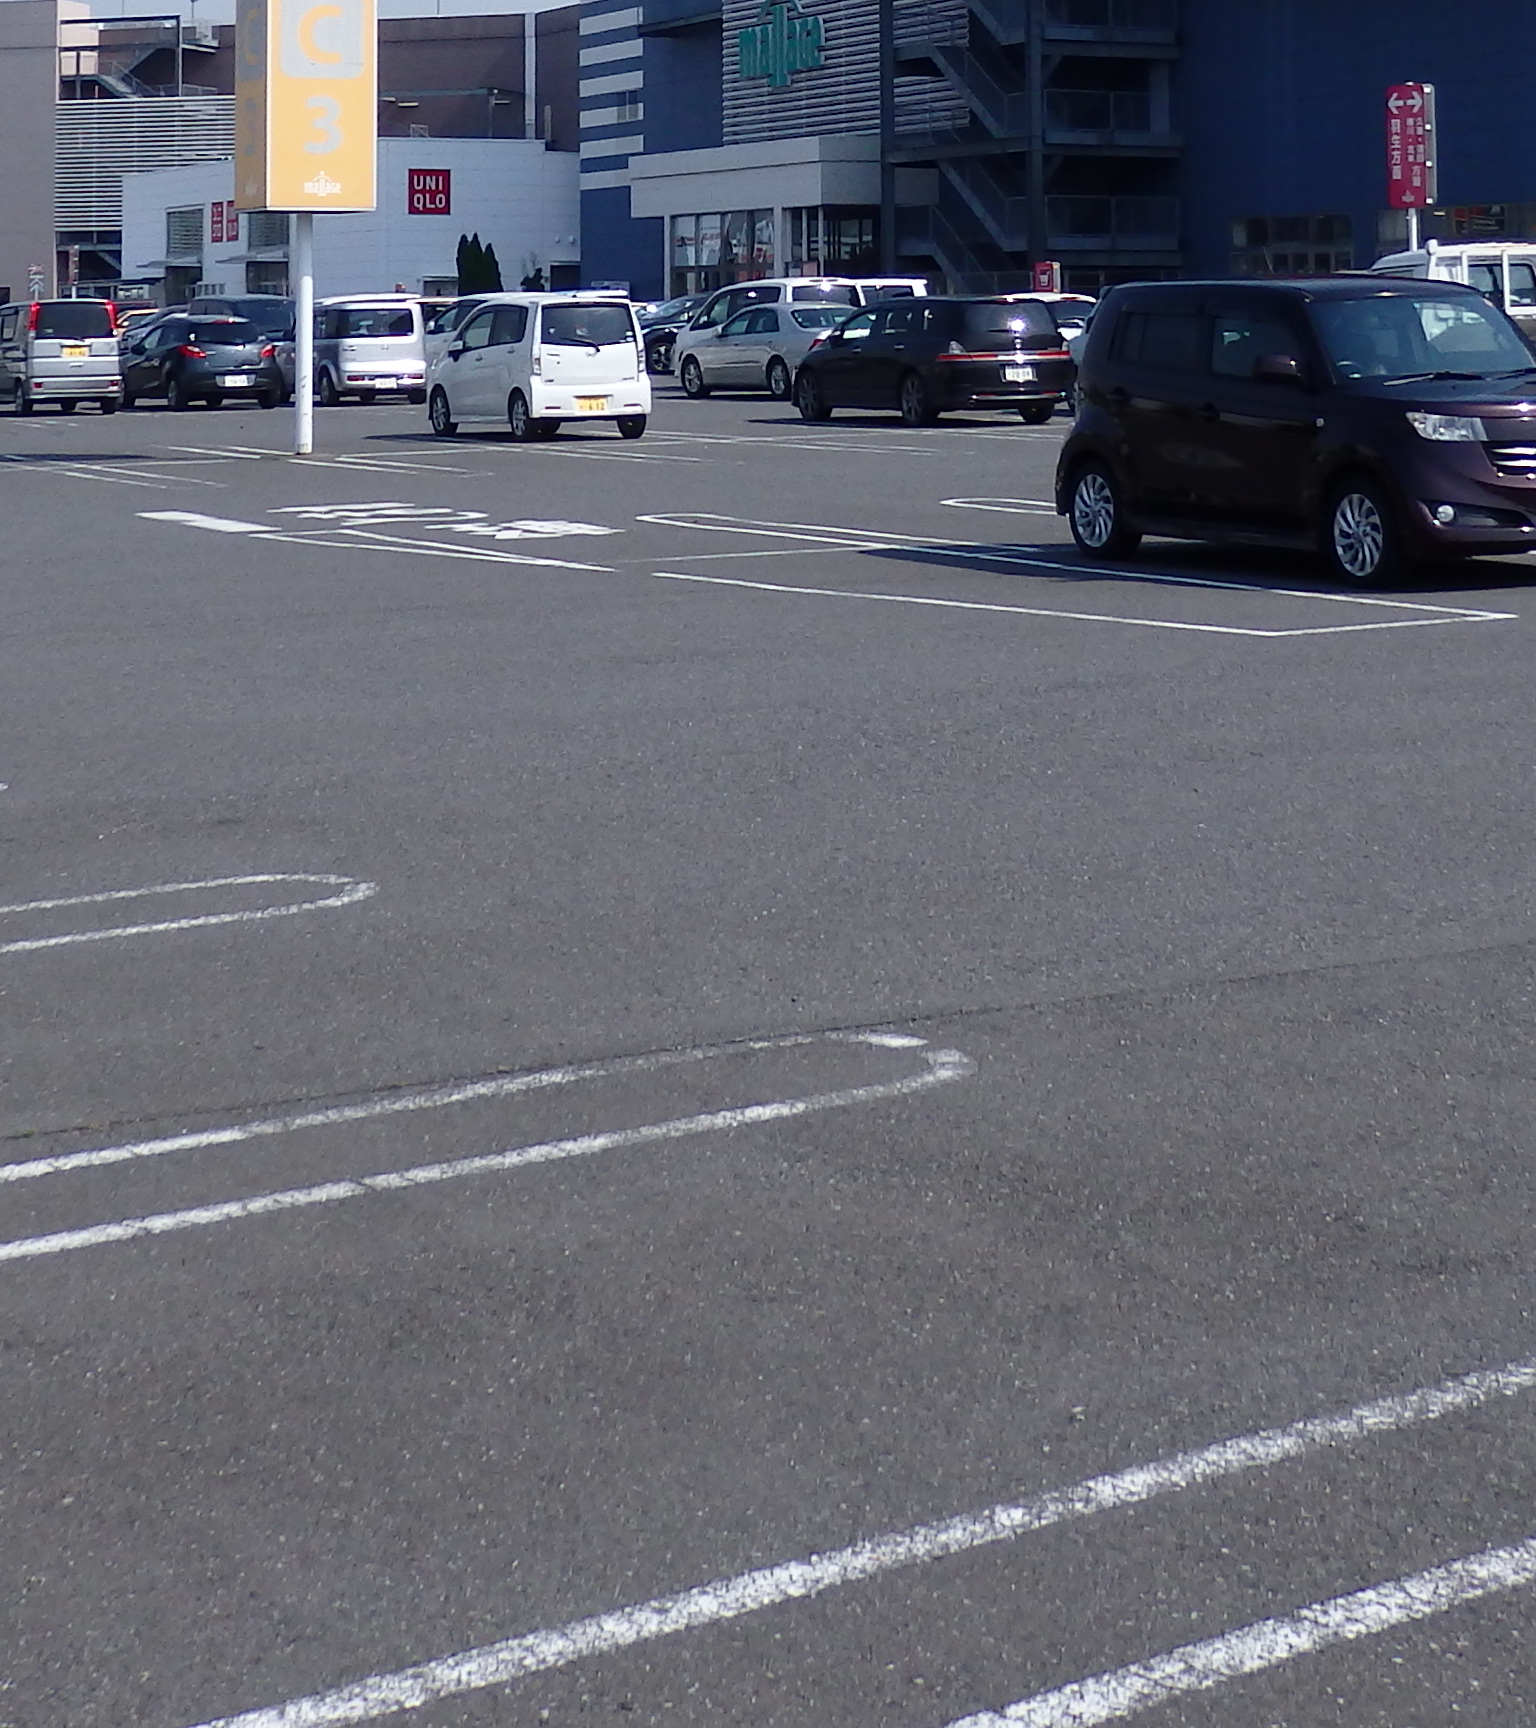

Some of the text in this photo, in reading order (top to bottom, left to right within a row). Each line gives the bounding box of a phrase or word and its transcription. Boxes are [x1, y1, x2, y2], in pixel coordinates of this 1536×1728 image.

[298, 3, 345, 64] C
[302, 95, 346, 156] 3
[413, 174, 444, 191] UNI
[413, 193, 446, 211] QLO
